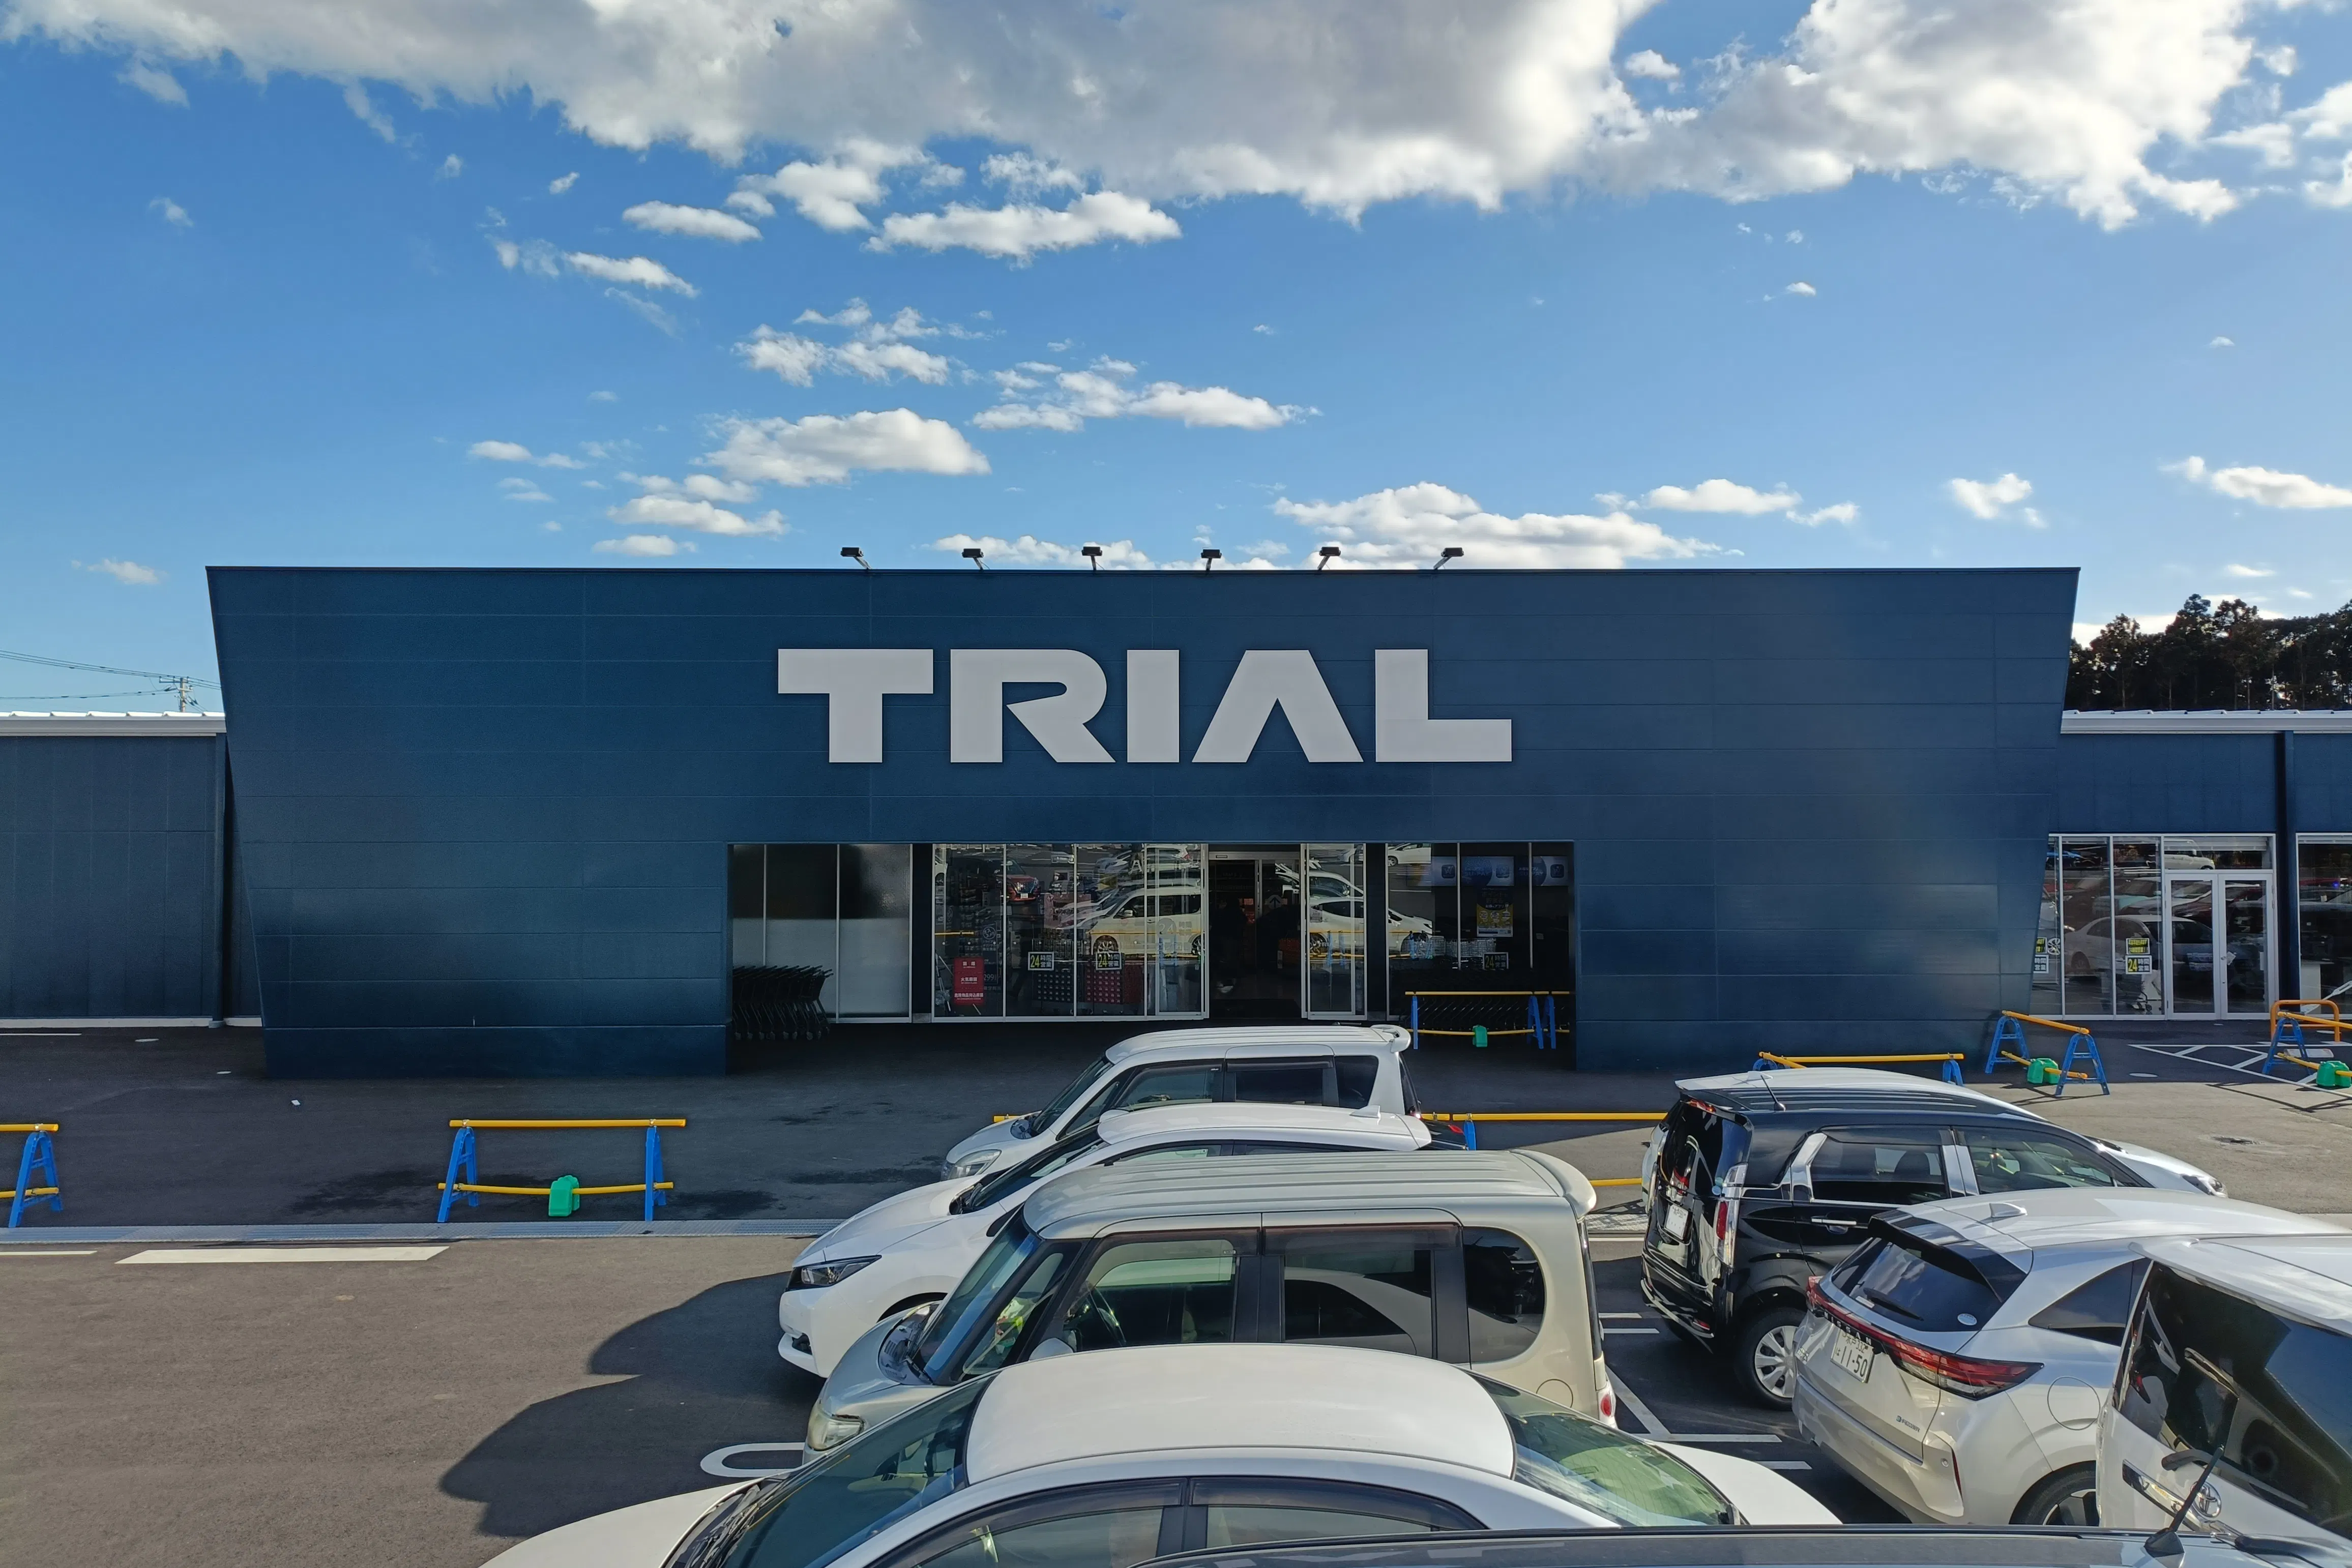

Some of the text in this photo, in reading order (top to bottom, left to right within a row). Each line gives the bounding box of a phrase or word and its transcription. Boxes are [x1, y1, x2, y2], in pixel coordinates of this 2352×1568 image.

[777, 648, 1512, 763] TRIAL
[1030, 954, 1040, 968] 24
[1098, 954, 1108, 968] 24
[1485, 955, 1494, 968] 24
[1824, 1311, 1872, 1346] NISSAN
[1840, 1345, 1868, 1378] 11-50
